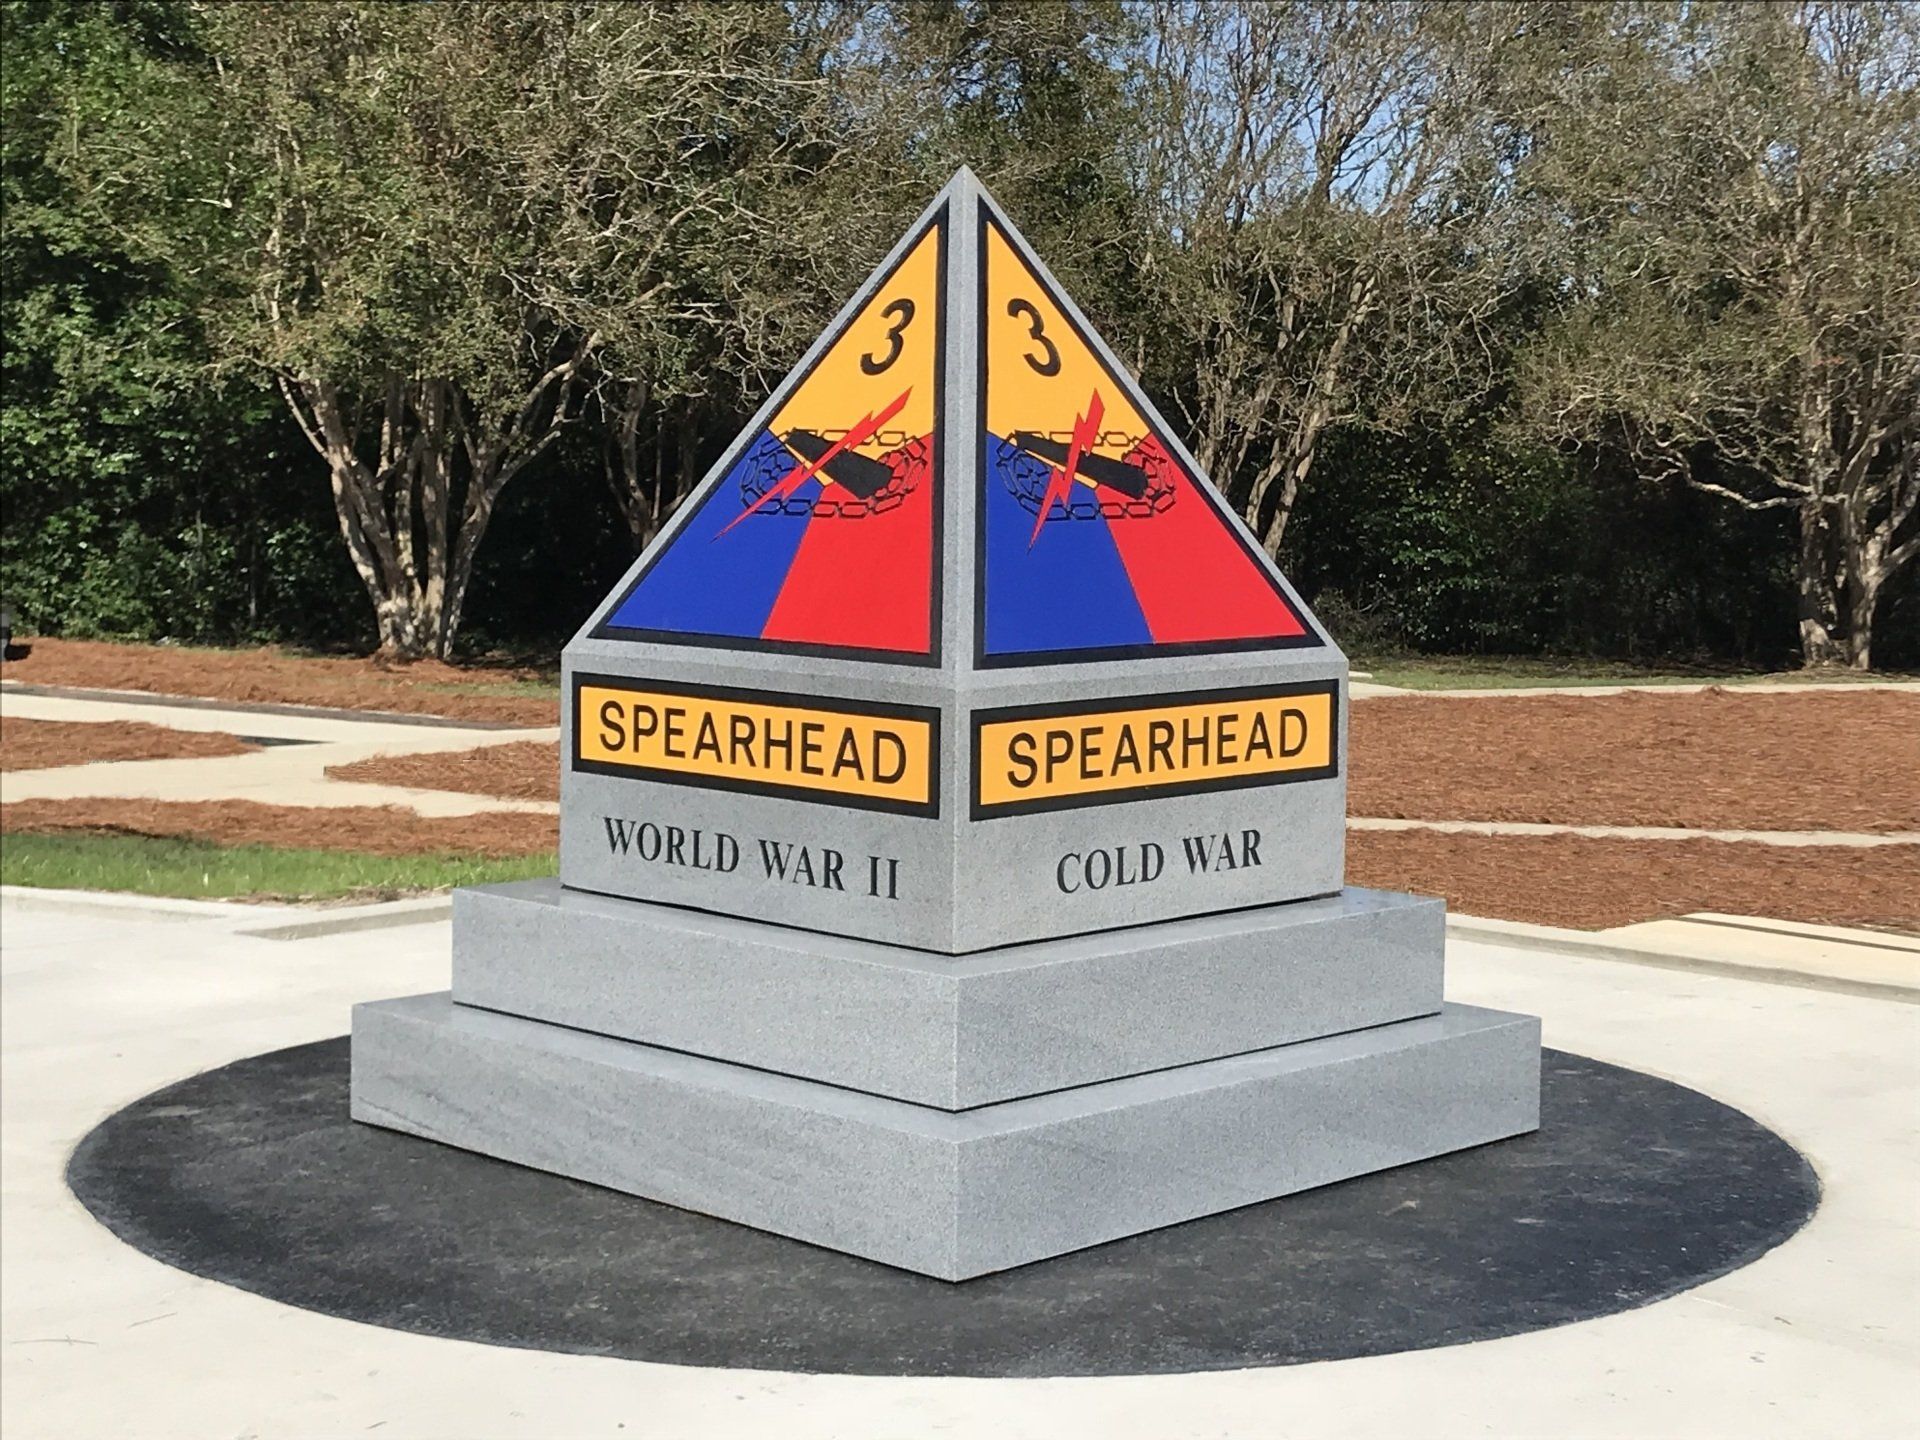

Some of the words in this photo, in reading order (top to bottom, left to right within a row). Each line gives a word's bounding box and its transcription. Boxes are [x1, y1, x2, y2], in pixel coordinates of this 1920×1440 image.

[860, 298, 915, 376] 3
[1007, 298, 1061, 377] 3
[599, 700, 906, 784] SPEARHEAD
[1007, 708, 1307, 788] SPEARHEAD
[603, 816, 739, 873] WORLD
[758, 839, 845, 891] WAR
[868, 856, 900, 900] II
[1057, 842, 1164, 894] COLD
[1182, 829, 1262, 875] WAR
